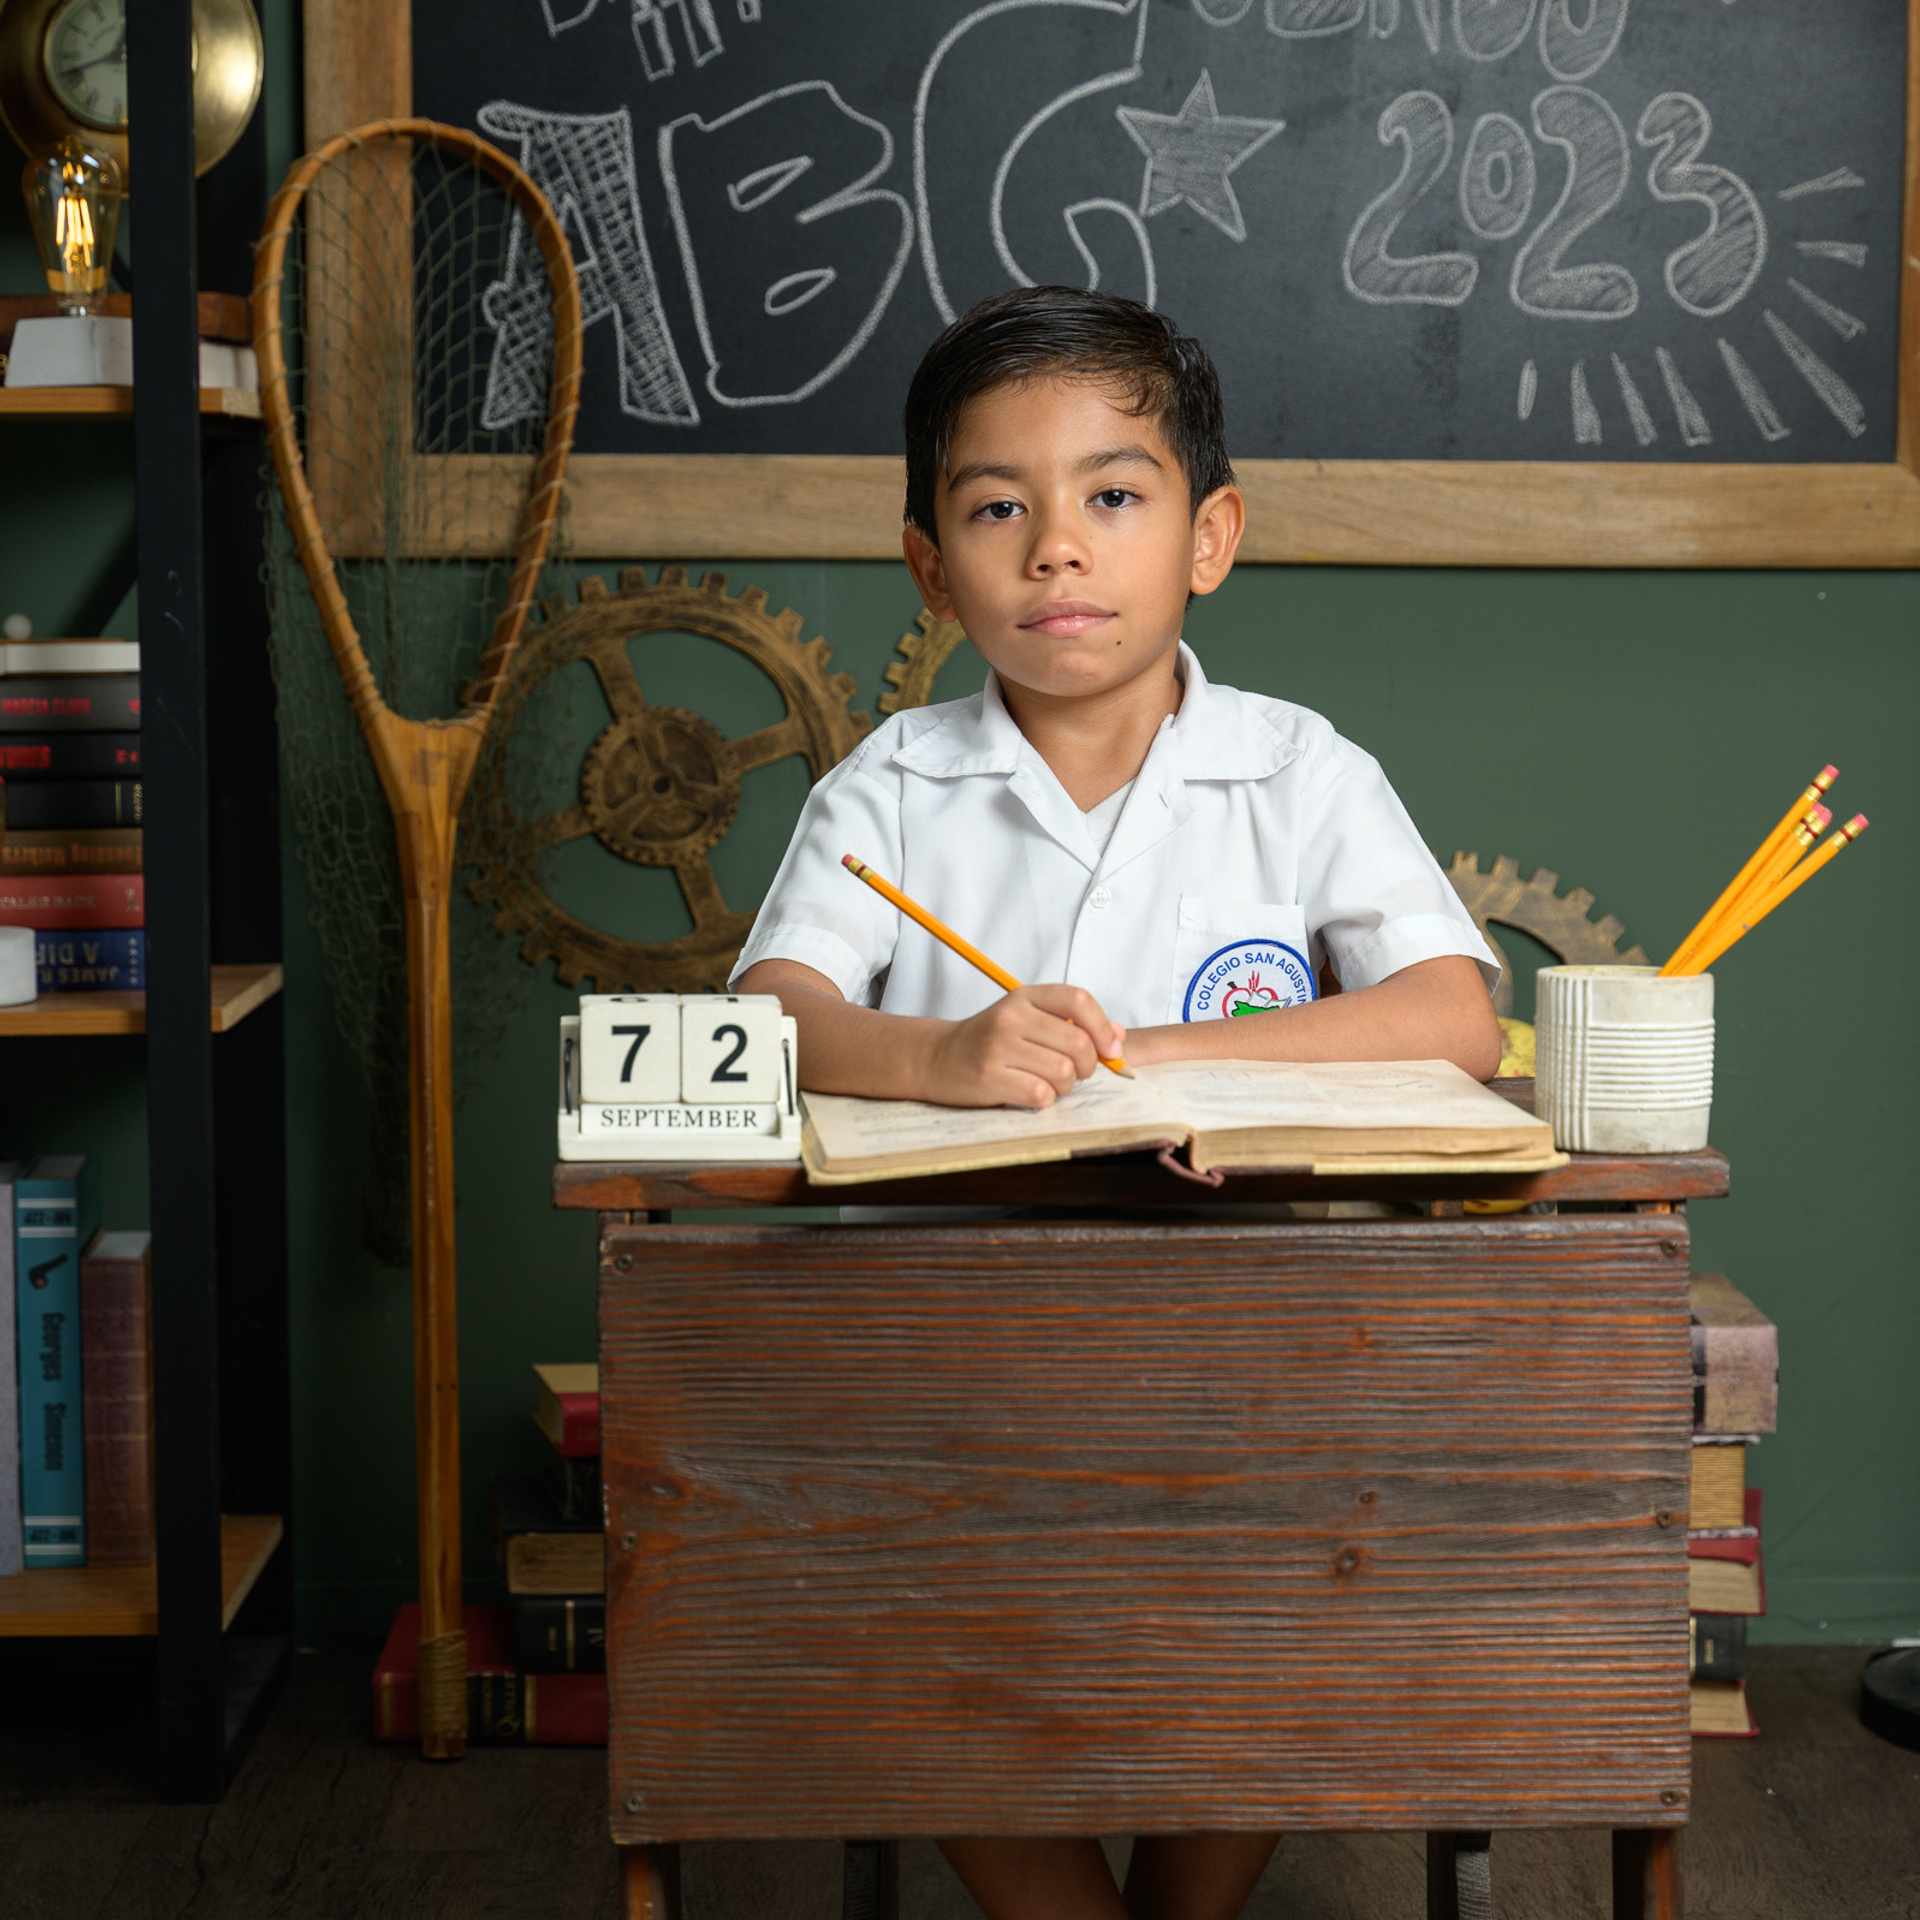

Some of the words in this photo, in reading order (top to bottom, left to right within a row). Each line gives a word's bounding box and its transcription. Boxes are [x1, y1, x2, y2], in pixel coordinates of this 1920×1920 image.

[1342, 84, 1768, 319] 2023
[58, 966, 121, 985] JAMES
[1197, 957, 1241, 1010] COLEGIO
[1244, 952, 1275, 965] SAN
[611, 1025, 651, 1083] 7
[711, 1024, 748, 1083] 2
[600, 1109, 758, 1128] SEPTEMBER
[40, 1312, 65, 1382] Georges
[44, 1403, 67, 1472] Simenon
